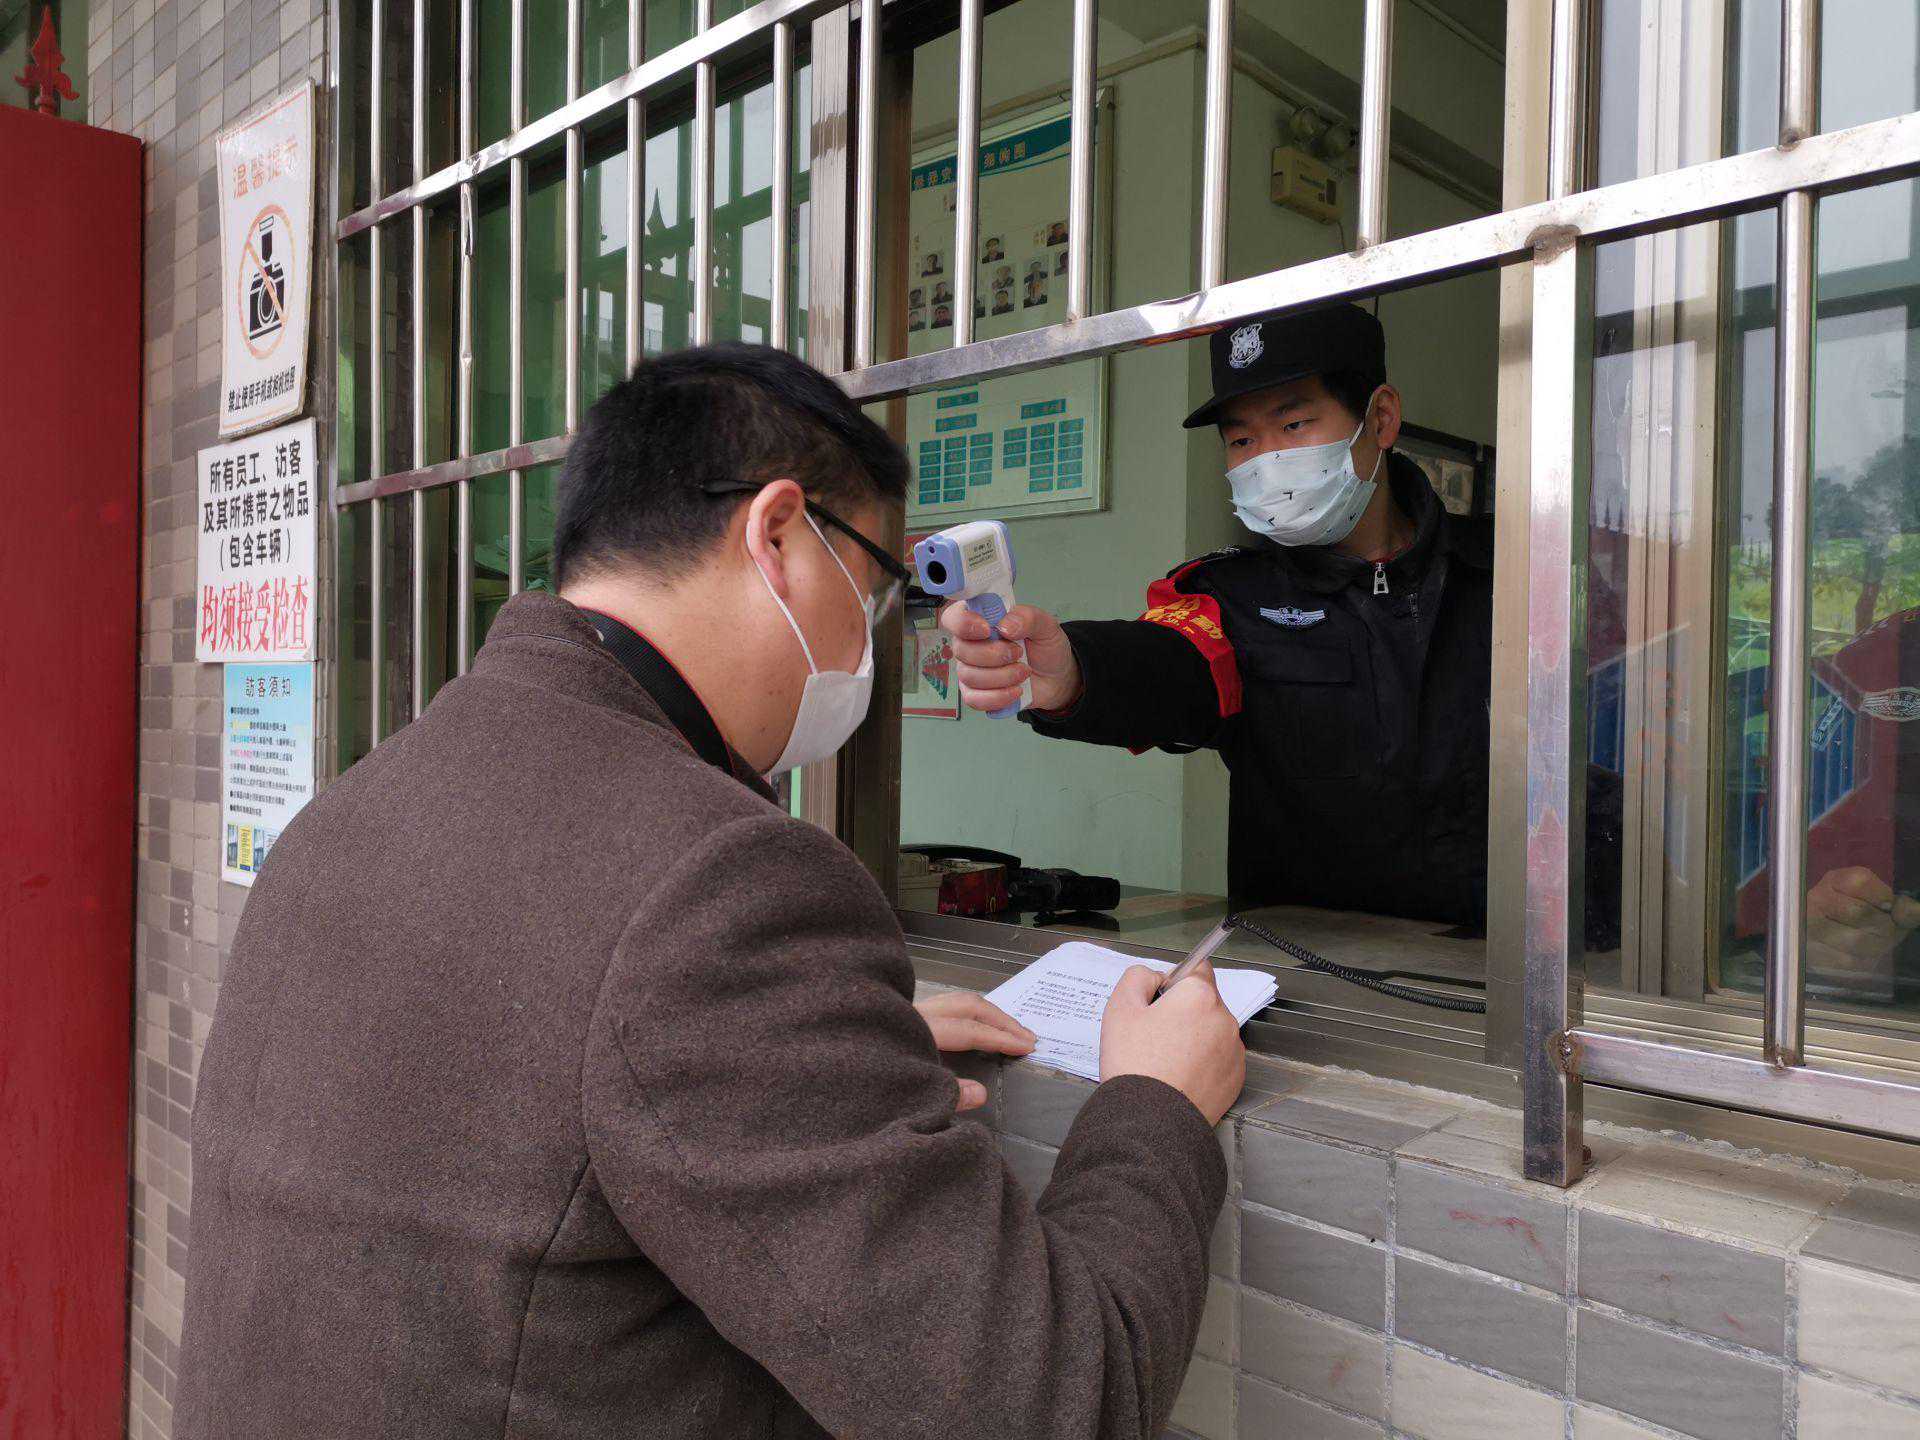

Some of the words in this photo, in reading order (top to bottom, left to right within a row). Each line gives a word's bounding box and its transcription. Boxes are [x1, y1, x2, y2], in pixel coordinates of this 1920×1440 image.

[233, 137, 299, 199] 温馨提示
[228, 366, 296, 412] 禁止使用手机或相机拍照
[209, 439, 301, 494] 所有员工、访客
[203, 481, 309, 534] 及其所携带之物品
[201, 575, 309, 653] 均须接受检查
